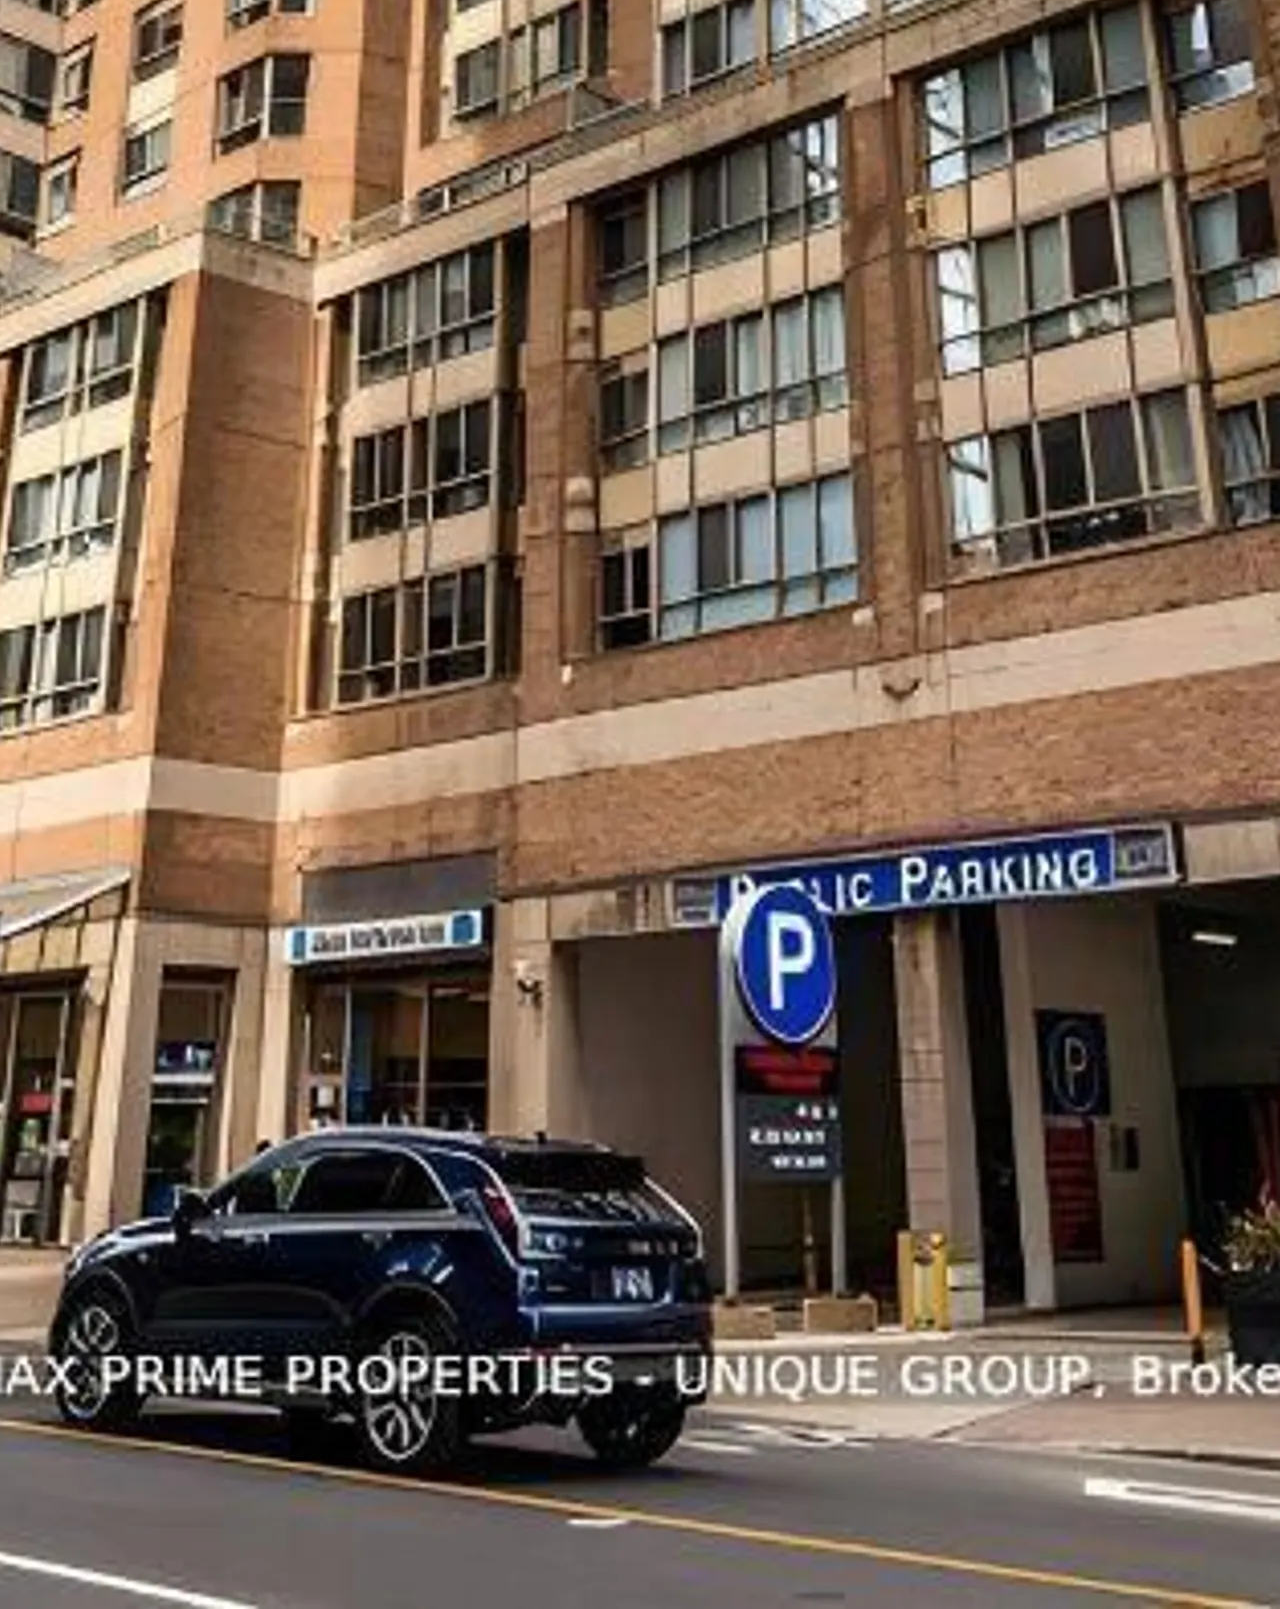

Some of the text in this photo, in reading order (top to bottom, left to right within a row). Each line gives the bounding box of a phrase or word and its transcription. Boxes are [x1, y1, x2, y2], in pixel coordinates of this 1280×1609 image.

[900, 848, 1099, 904] PARKING
[767, 910, 816, 1010] P
[1064, 1036, 1087, 1098] P
